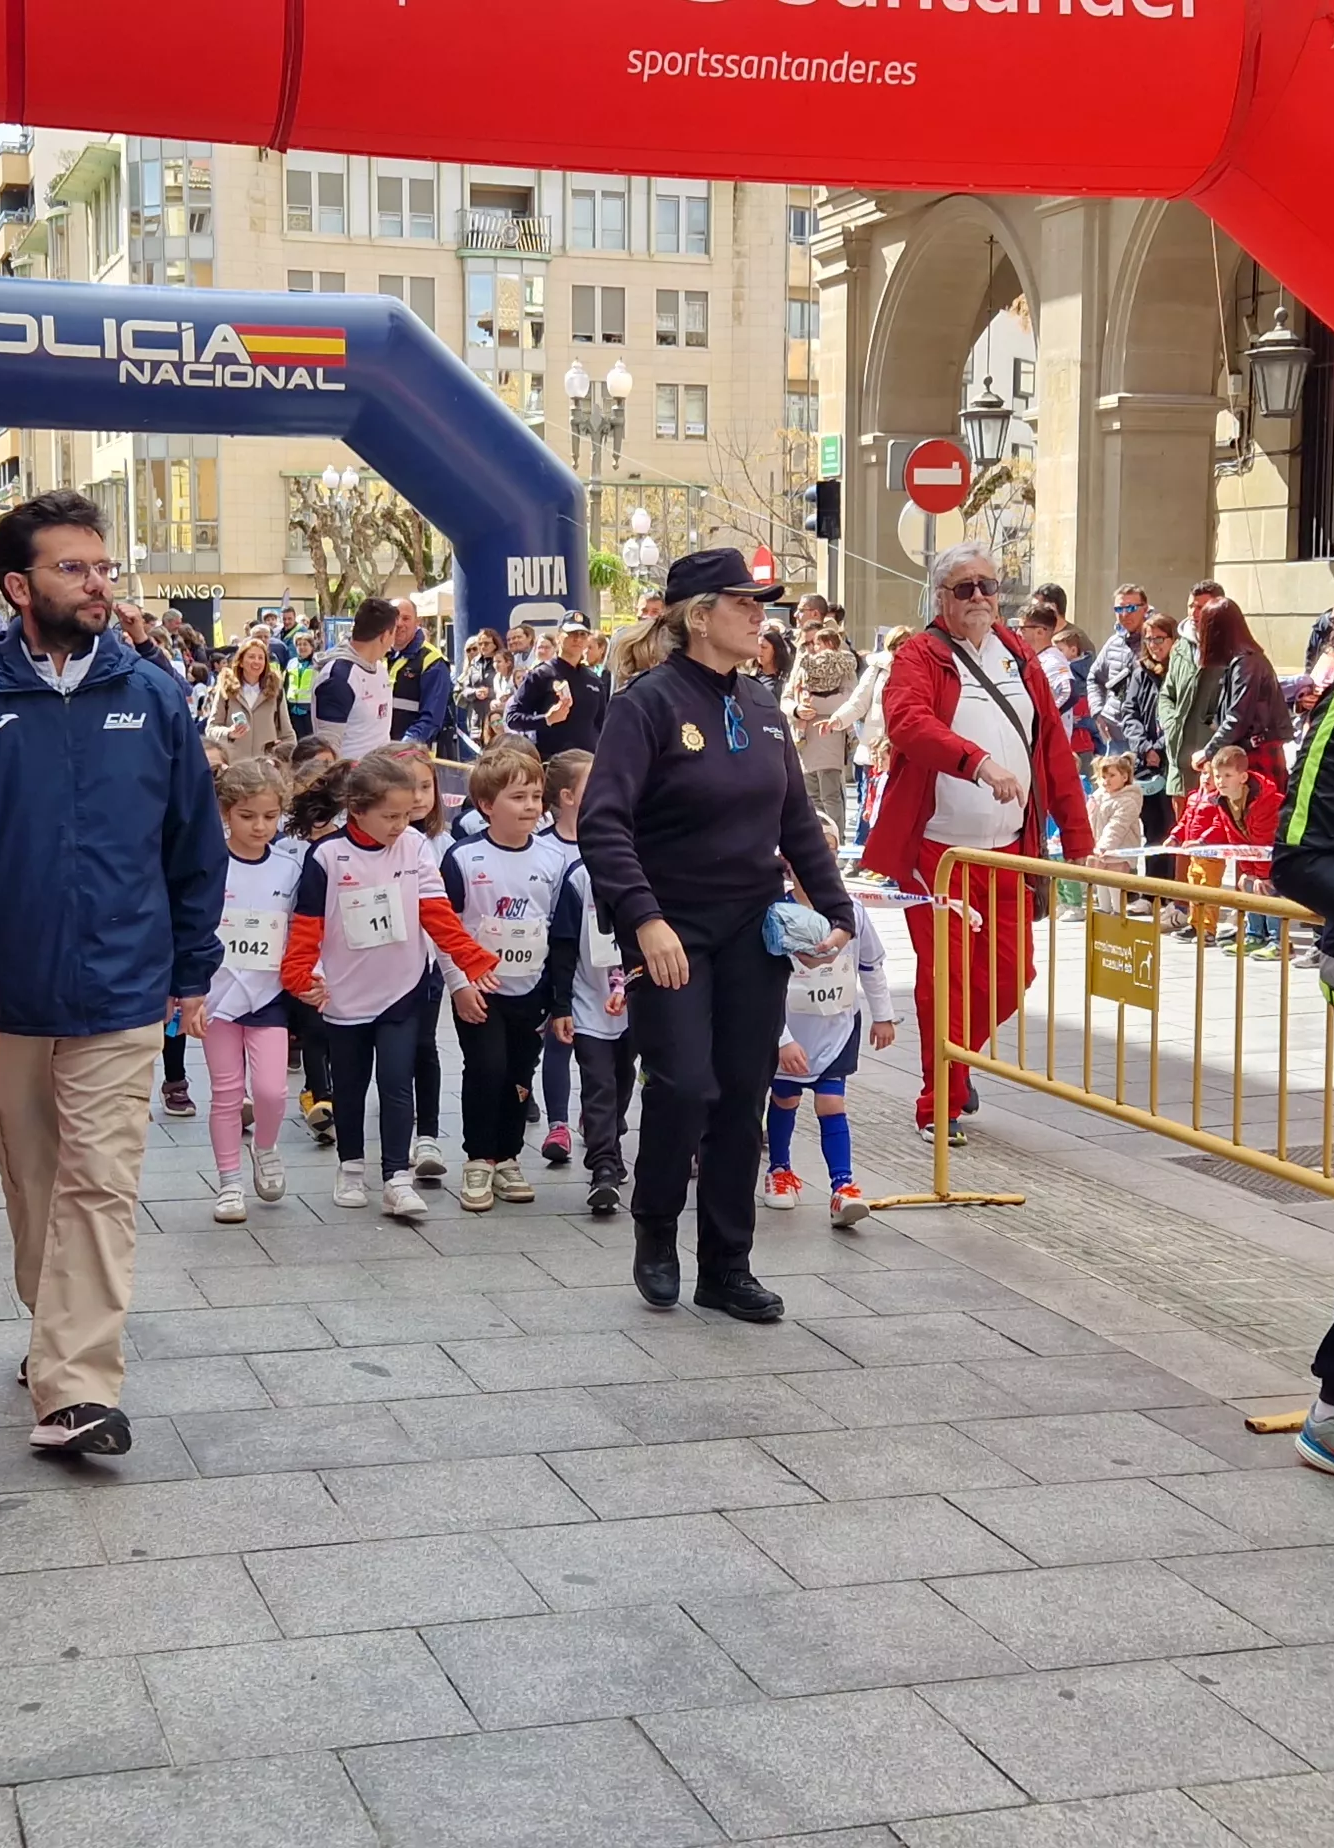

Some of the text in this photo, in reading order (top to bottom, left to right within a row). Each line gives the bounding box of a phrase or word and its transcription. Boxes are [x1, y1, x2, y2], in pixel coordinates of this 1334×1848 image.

[627, 47, 917, 85] sportssantander.es
[119, 360, 345, 391] NACIONAL
[507, 556, 568, 597] RUTA
[157, 584, 225, 599] MANGO
[369, 914, 393, 931] 11
[229, 940, 269, 955] 1042
[496, 948, 533, 962] 1009
[807, 987, 843, 1003] 1047
